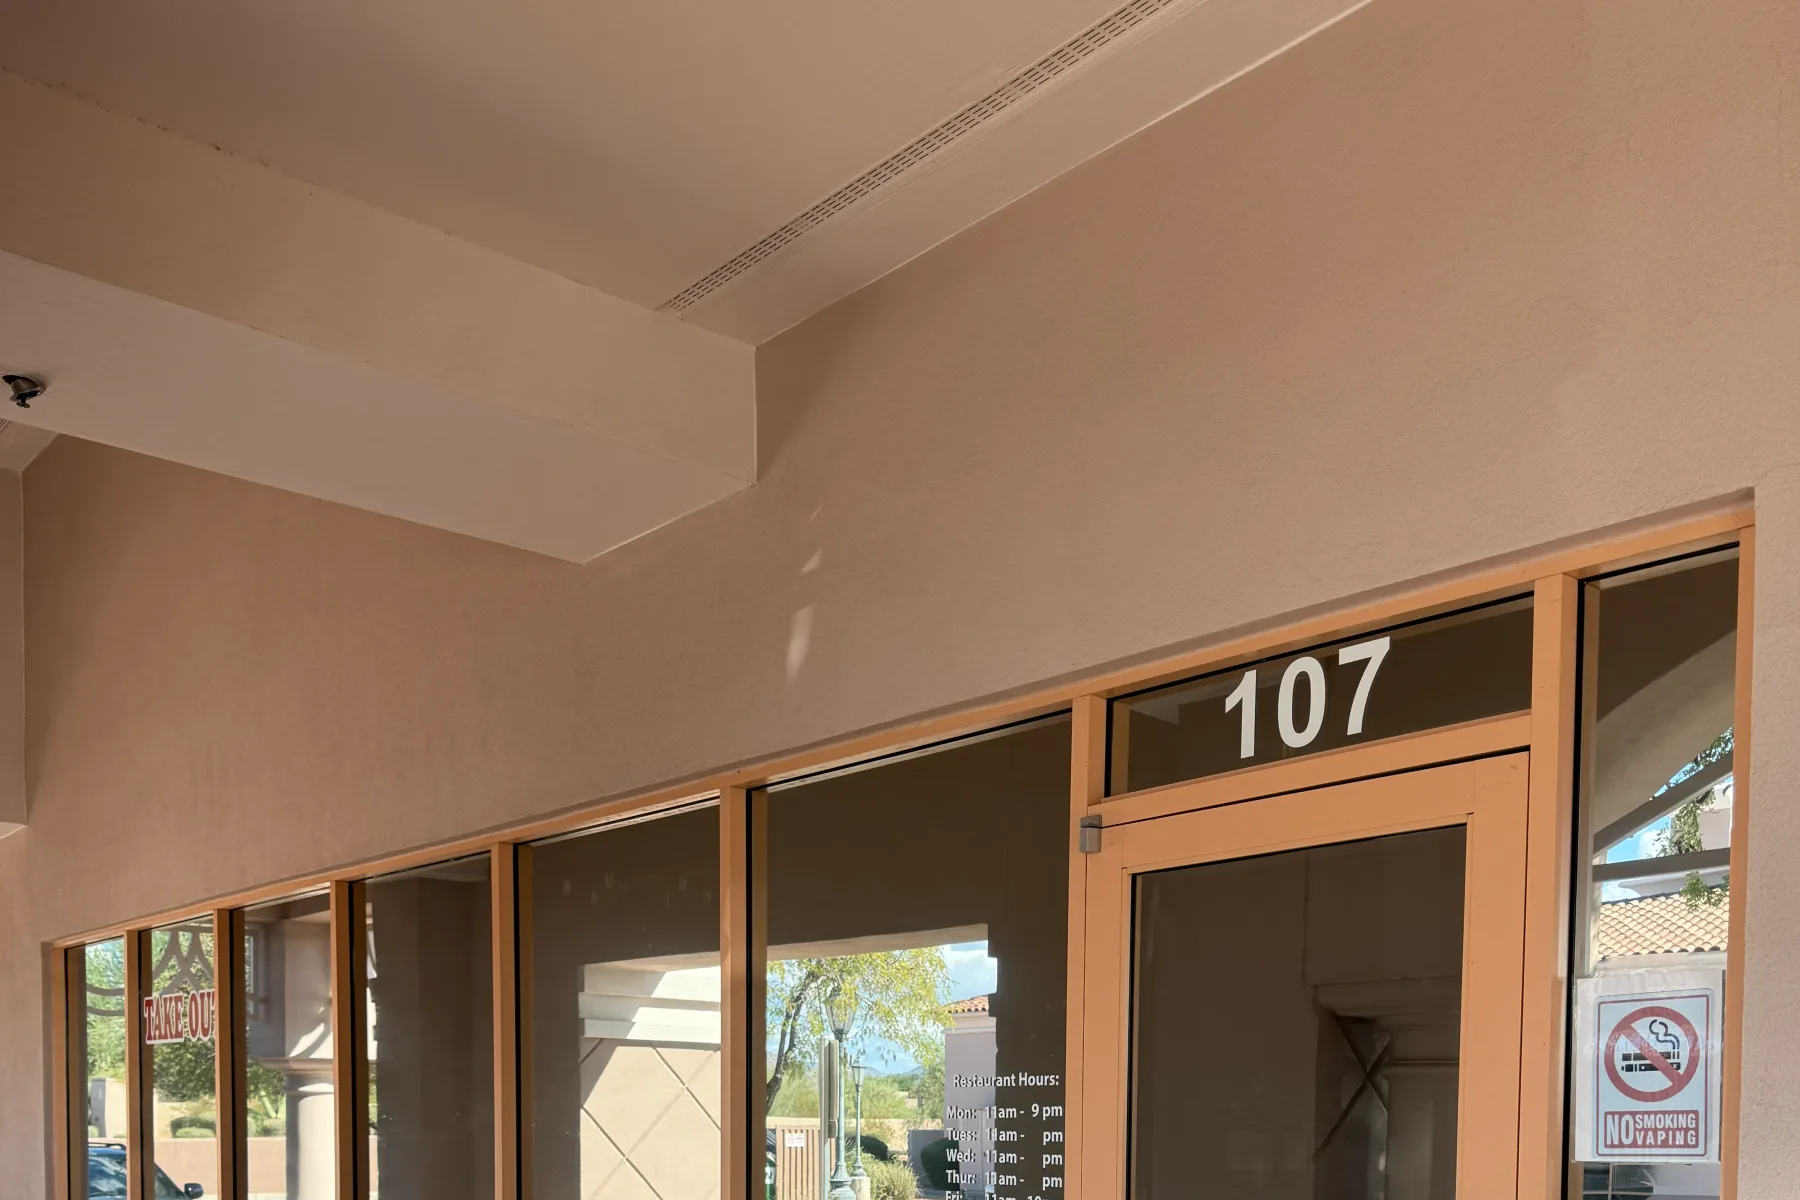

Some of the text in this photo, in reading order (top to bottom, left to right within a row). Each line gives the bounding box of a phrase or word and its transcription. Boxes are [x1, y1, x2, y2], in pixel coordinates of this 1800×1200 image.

[1225, 636, 1390, 759] 107
[144, 989, 215, 1044] TAKE OU
[953, 1072, 1059, 1088] Restaurant Hours:
[947, 1106, 977, 1119] Mon:
[985, 1106, 1017, 1119] 11am
[1031, 1103, 1040, 1118] 9
[1043, 1105, 1063, 1121] pm
[946, 1128, 977, 1141] Tues:
[986, 1128, 1018, 1142] 11am
[1043, 1131, 1063, 1146] pm
[1606, 1113, 1696, 1146] NO SMOKING
[1636, 1130, 1696, 1146] VAPING
[946, 1149, 976, 1163] Wed:
[985, 1150, 1017, 1164] 11am
[1043, 1153, 1063, 1169] pm
[945, 1170, 976, 1184] Thur:
[985, 1172, 1017, 1186] 11am
[1043, 1176, 1062, 1191] pm
